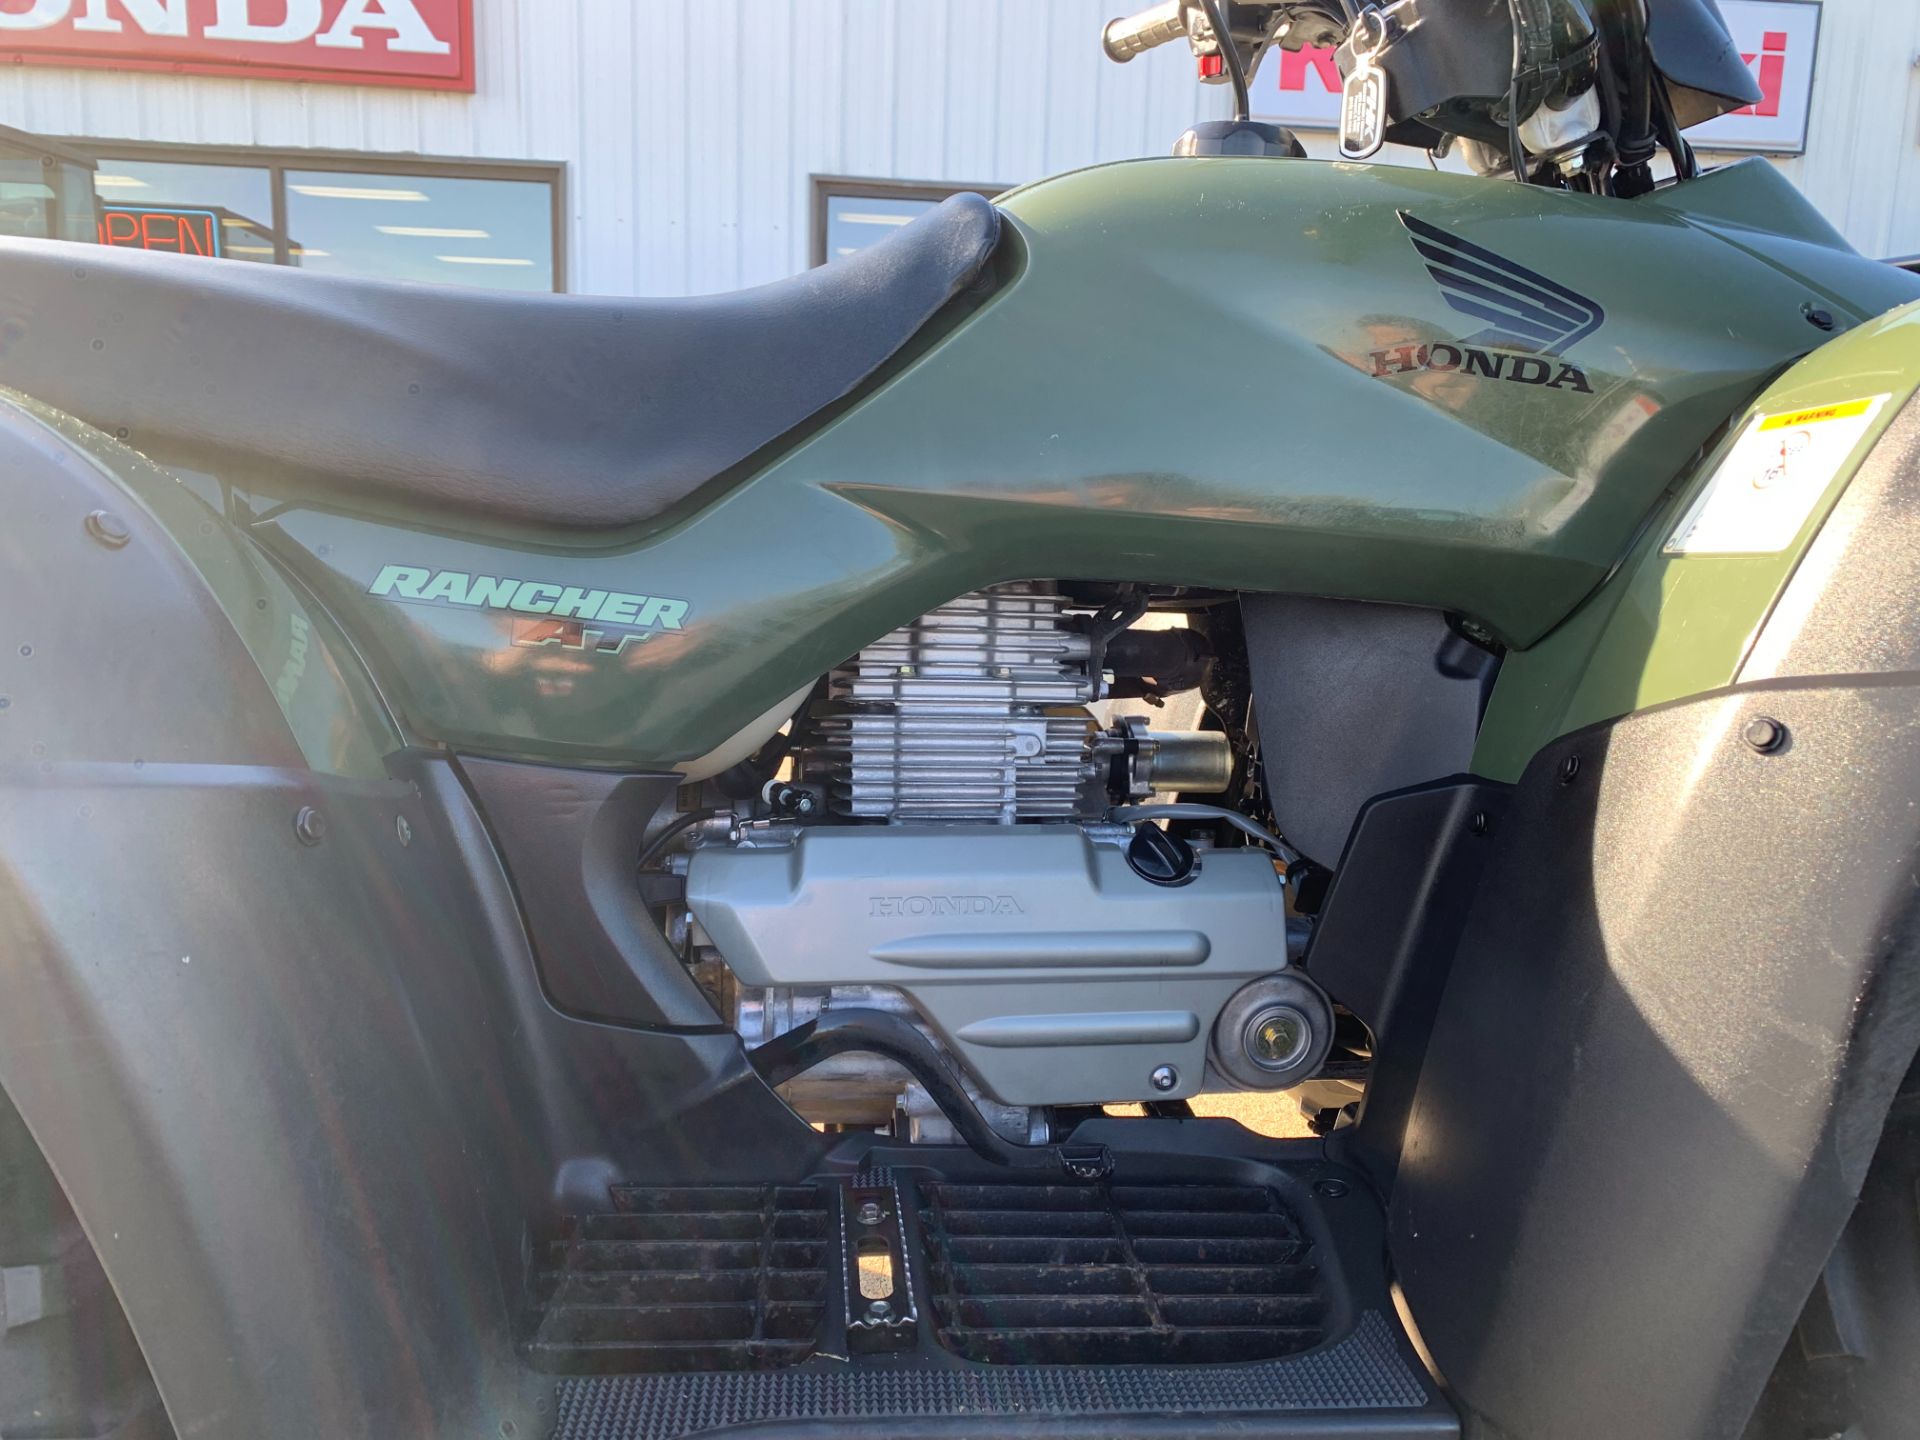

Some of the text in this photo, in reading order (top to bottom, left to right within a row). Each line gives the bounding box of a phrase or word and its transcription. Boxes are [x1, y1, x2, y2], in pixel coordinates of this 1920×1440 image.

[0, 0, 450, 55] NDA
[98, 213, 212, 257] PEN
[1368, 343, 1594, 393] HONDA
[367, 564, 690, 630] RANCHER
[512, 618, 650, 655] AT
[868, 895, 1025, 917] HONDA
